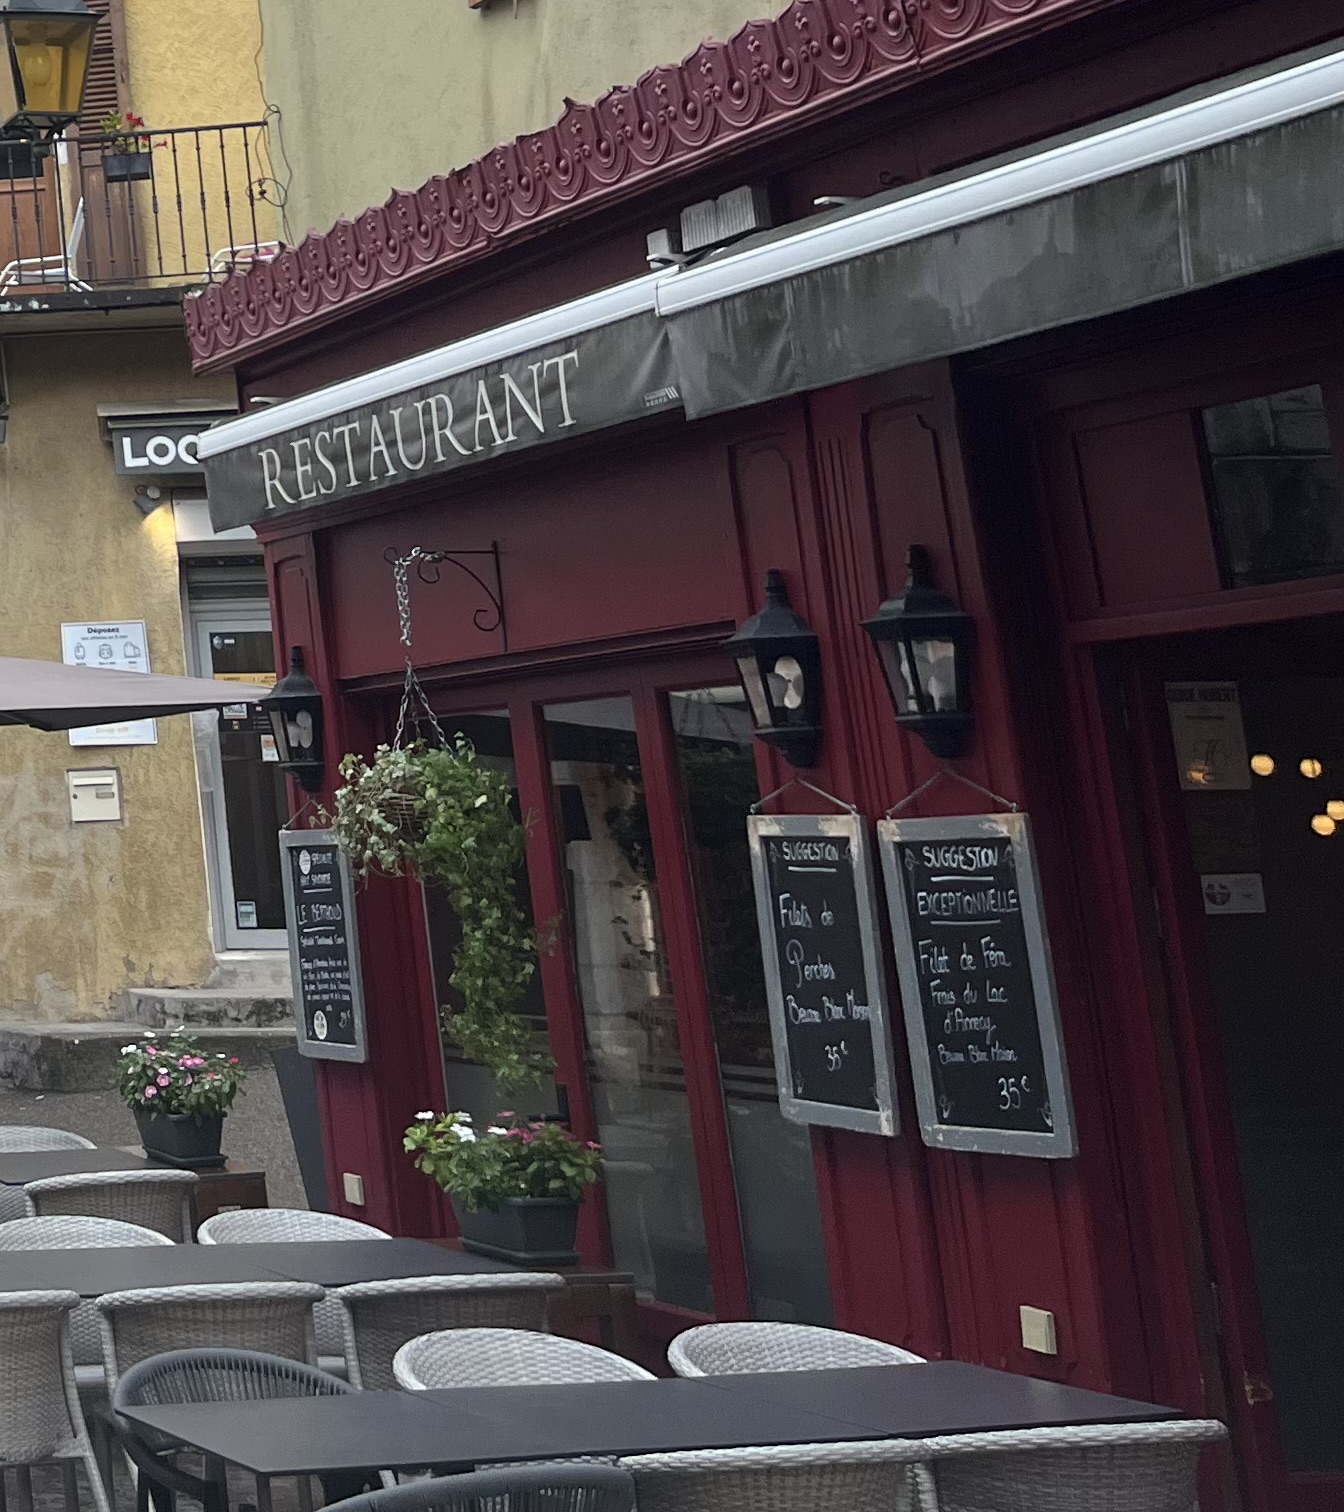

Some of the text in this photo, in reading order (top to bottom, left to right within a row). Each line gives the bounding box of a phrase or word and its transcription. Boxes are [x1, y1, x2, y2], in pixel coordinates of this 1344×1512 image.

[257, 349, 580, 511] RESTAURANT
[782, 840, 839, 861] SUGGESTION
[922, 845, 999, 871] SUGGESTION
[820, 898, 834, 926] de
[917, 888, 1020, 916] EXCEPTIONNELLE
[918, 938, 951, 975] Filet
[960, 942, 976, 971] de
[929, 979, 1009, 1007] Frais du Lac
